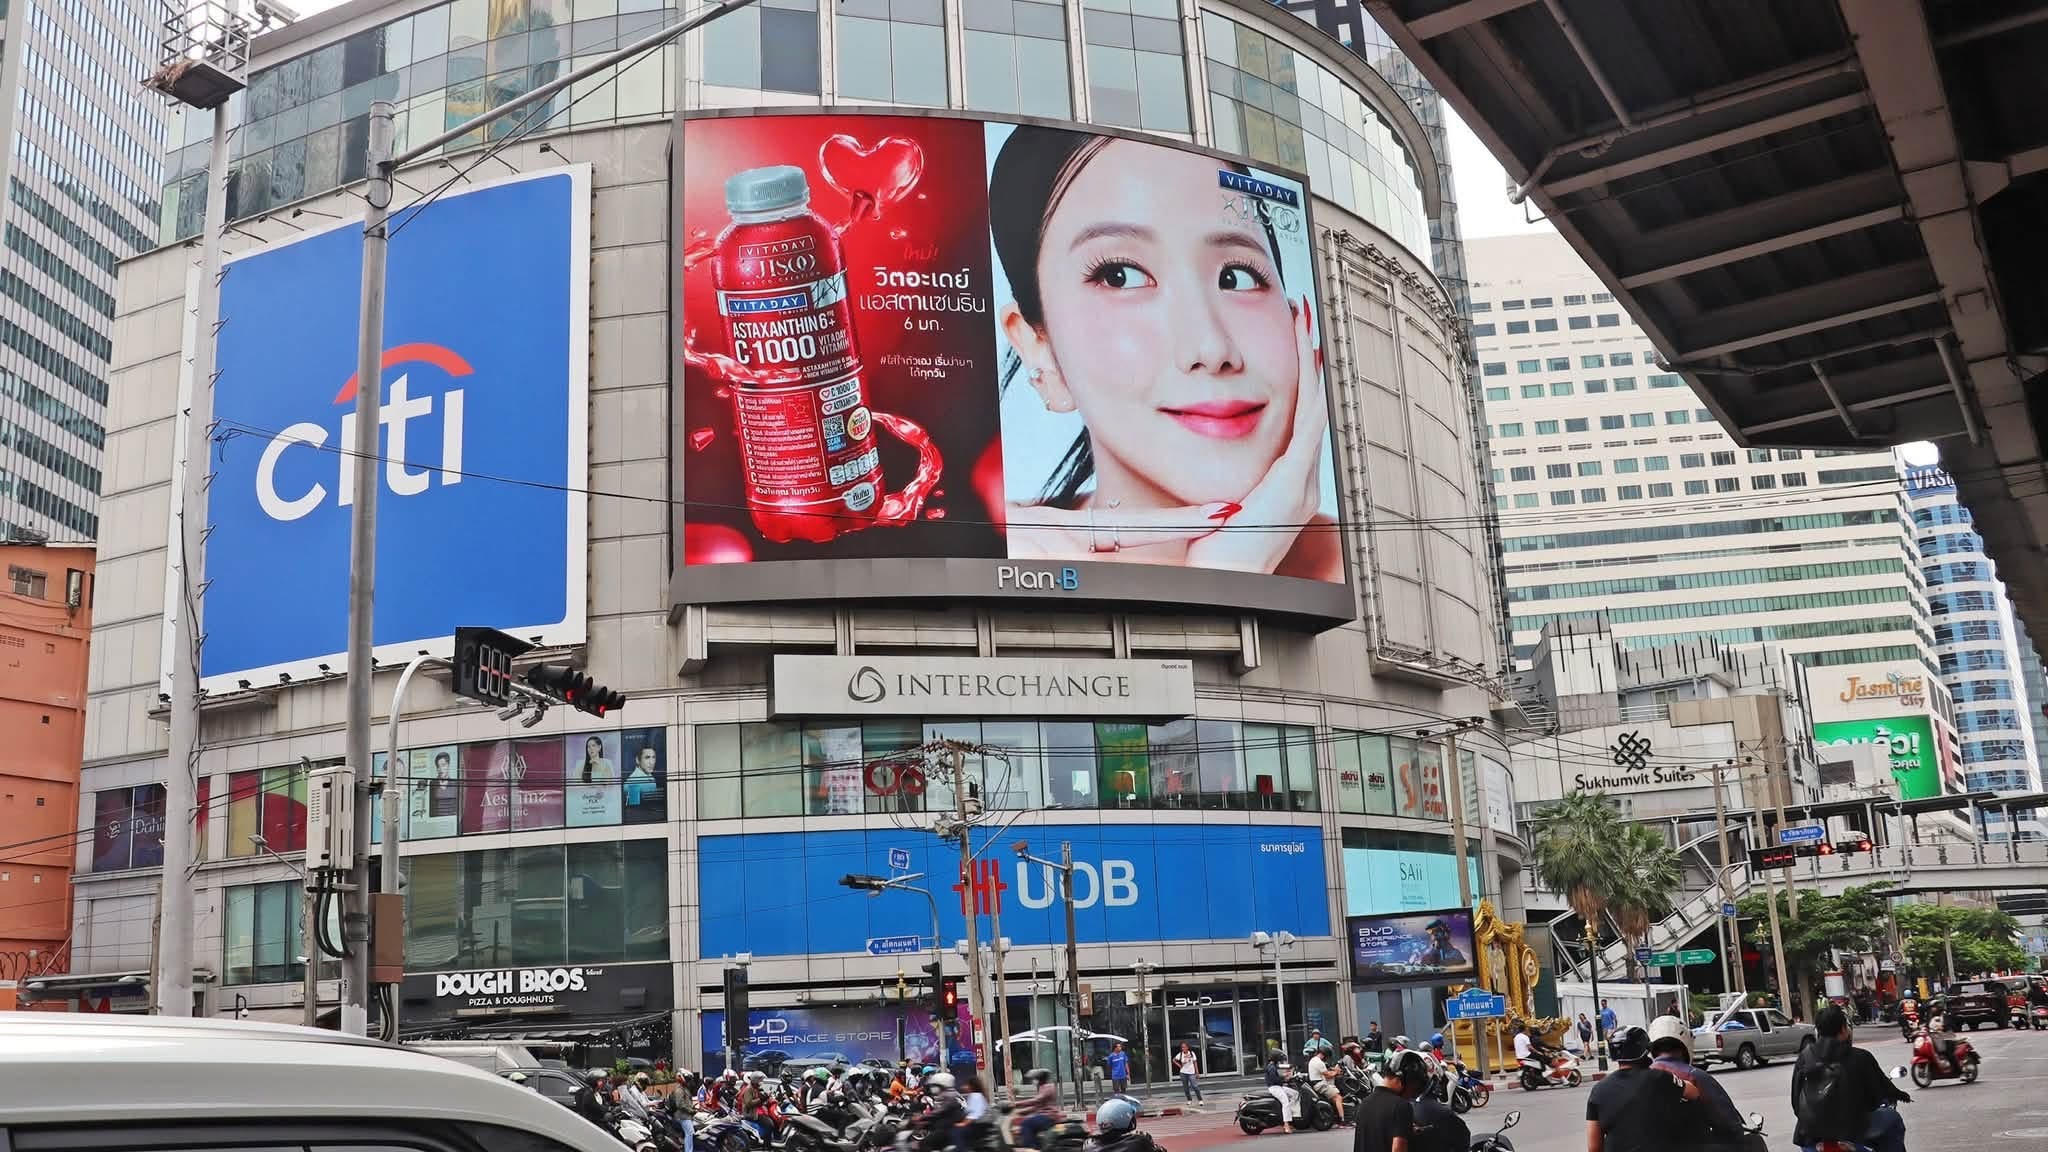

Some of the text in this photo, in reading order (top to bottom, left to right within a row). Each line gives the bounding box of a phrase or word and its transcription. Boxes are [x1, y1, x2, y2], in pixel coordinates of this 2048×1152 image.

[1226, 175, 1292, 202] VITADAY
[746, 239, 806, 254] VITADAY
[873, 266, 970, 289] วิตอะเดย์
[733, 298, 801, 311] VITADAY
[859, 292, 986, 313] แอสตาแซนธิน
[732, 315, 818, 339] ASTAXANTHIN
[903, 316, 944, 331] 6 มก.
[256, 373, 464, 521] citi
[896, 673, 1131, 699] INTERCHANGE
[1840, 672, 1923, 703] Jasmine
[1901, 694, 1926, 708] City
[1575, 767, 1696, 791] Sukhumvit Suites
[1260, 842, 1305, 855] ธนาคารยูโอบี
[1017, 859, 1139, 909] UOB
[1359, 926, 1394, 937] BYD
[436, 967, 588, 997] DOUGH BROS.
[468, 995, 555, 1006] PIZZA & DOUGHNUTS
[835, 1031, 892, 1042] STORE
